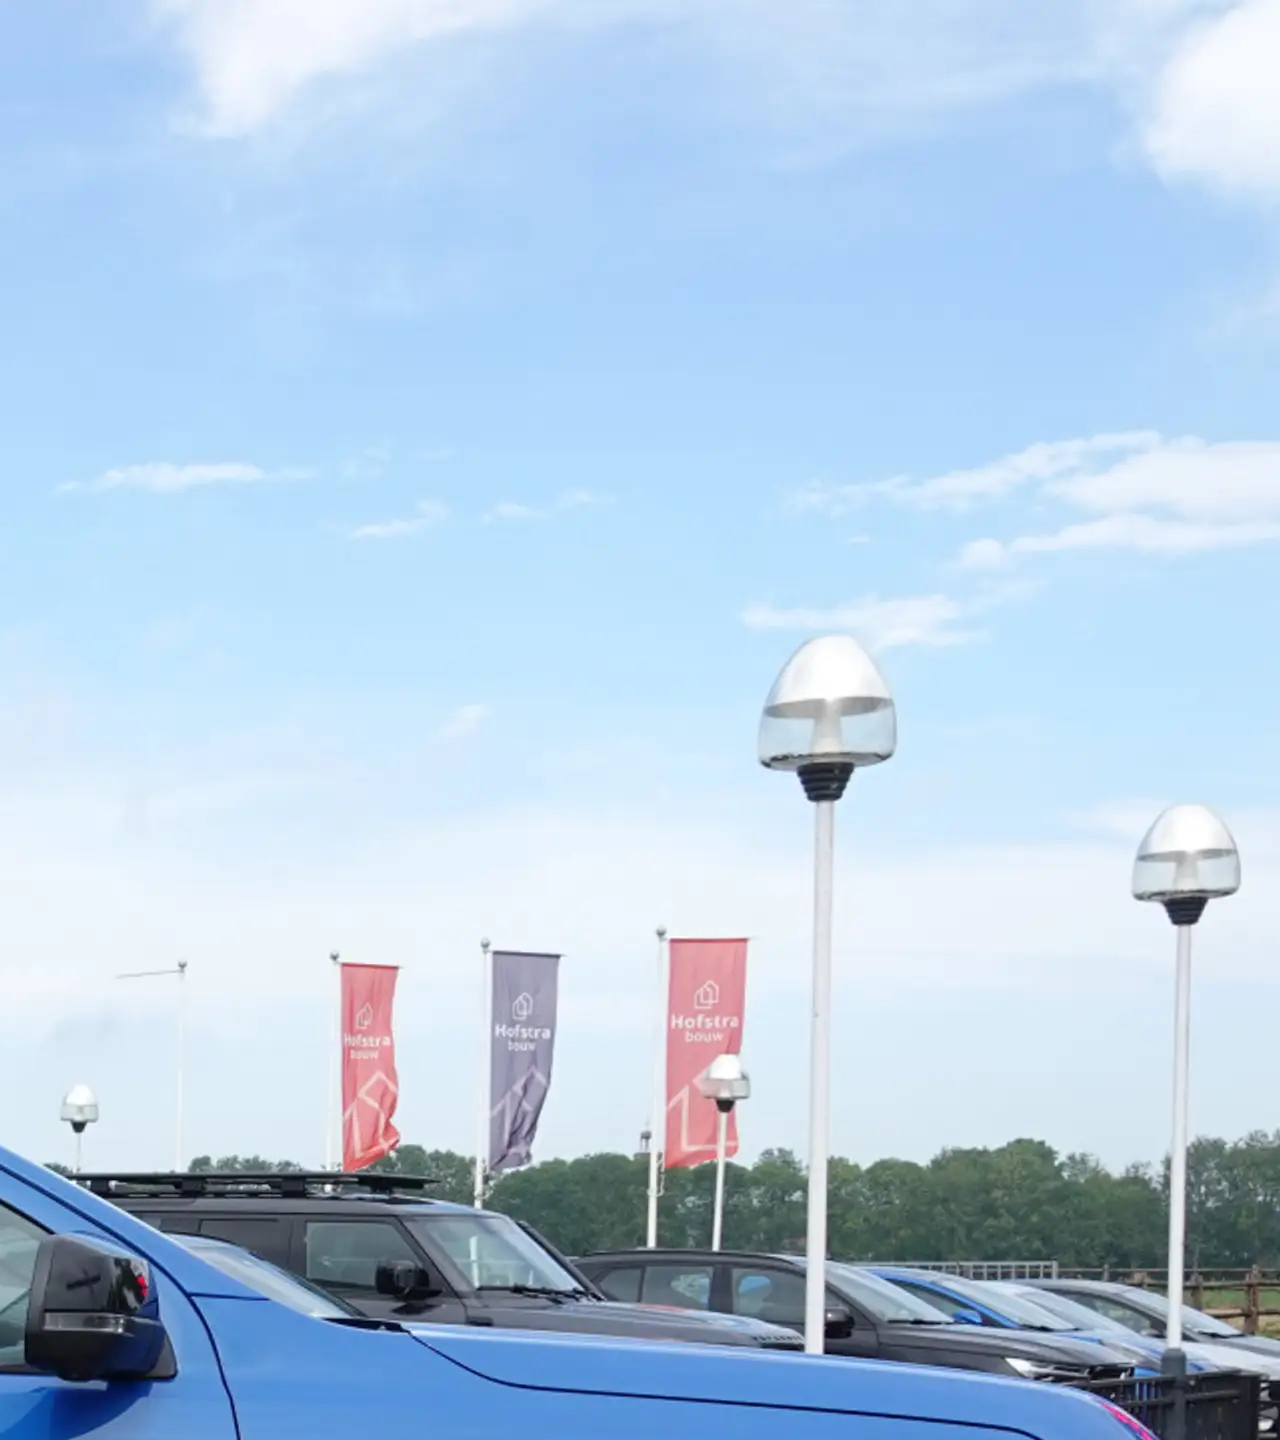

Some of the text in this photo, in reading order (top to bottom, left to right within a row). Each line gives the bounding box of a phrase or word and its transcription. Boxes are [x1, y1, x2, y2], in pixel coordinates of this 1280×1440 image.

[670, 1013, 740, 1029] Hofstra
[495, 1023, 552, 1040] Hofstra
[684, 1030, 724, 1043] bouw
[507, 1039, 537, 1052] bouw
